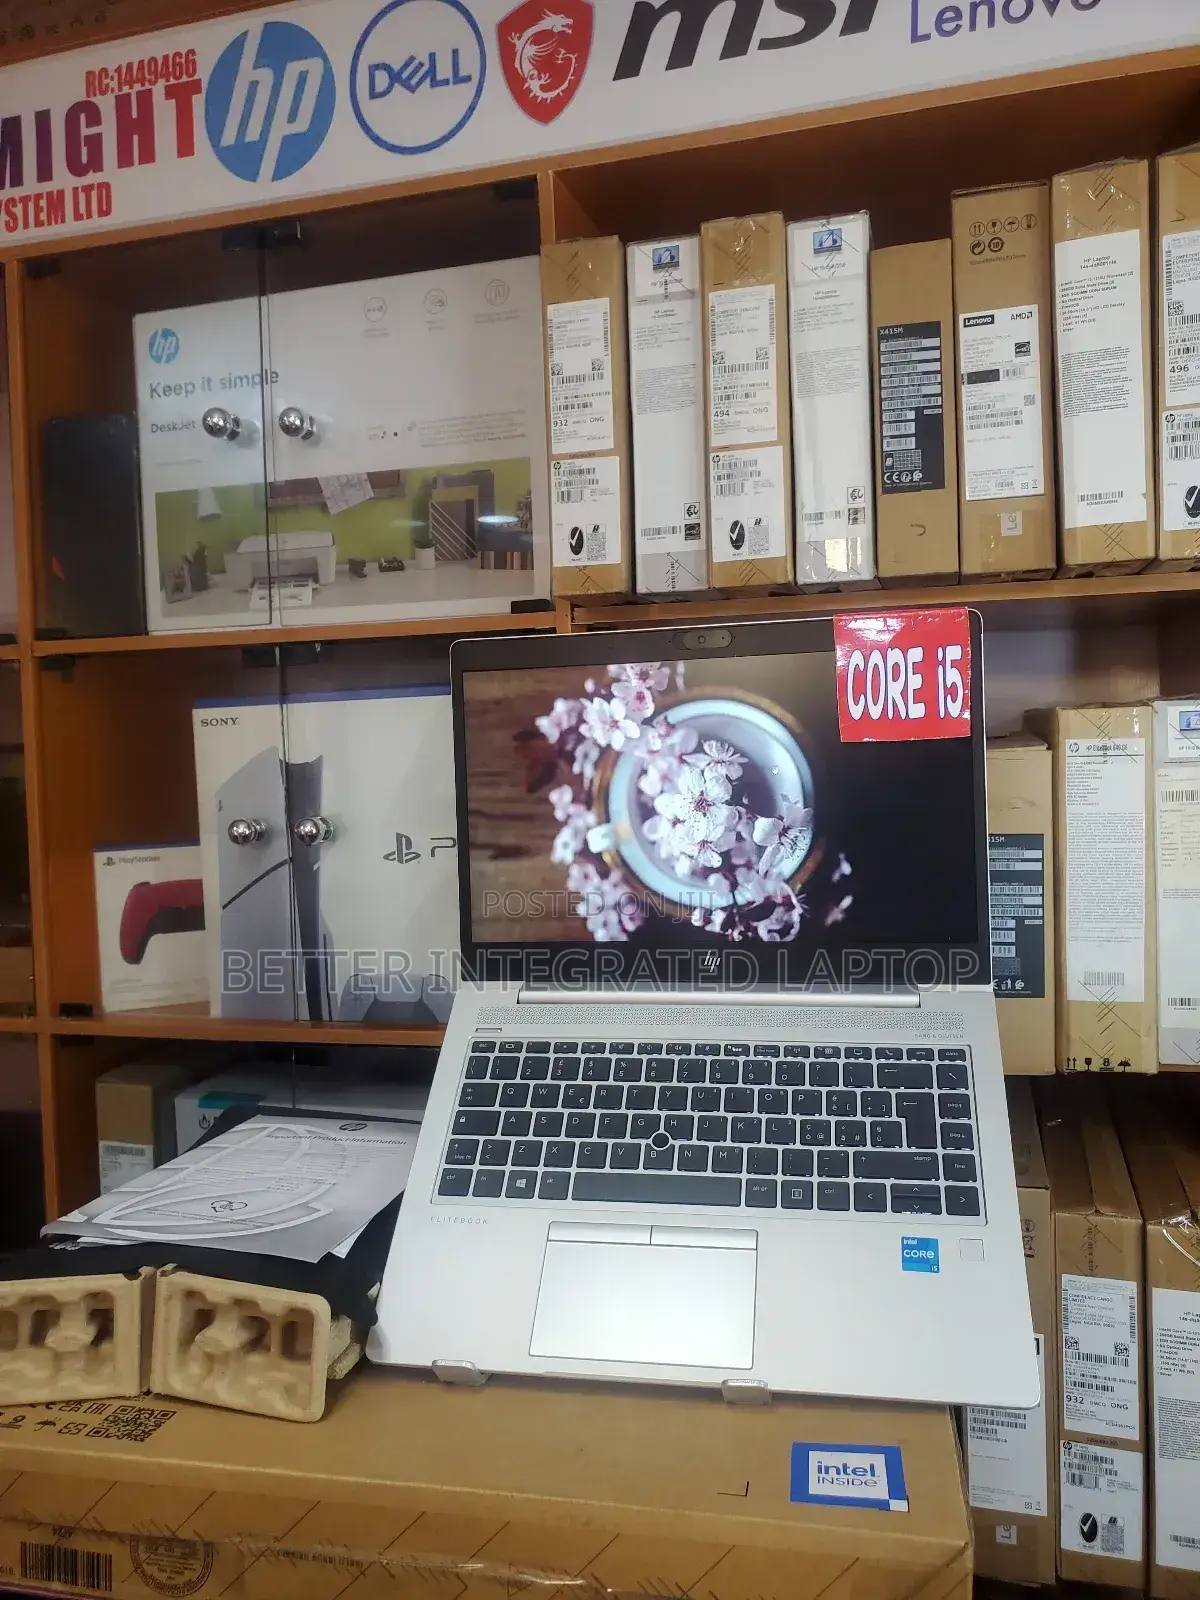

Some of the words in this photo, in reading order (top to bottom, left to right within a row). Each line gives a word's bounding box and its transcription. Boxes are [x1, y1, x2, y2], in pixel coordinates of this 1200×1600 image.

[85, 49, 197, 98] RC:1449466
[368, 48, 472, 101] DELL
[0, 188, 66, 233] STEM
[72, 181, 112, 222] LTD
[965, 316, 992, 326] Lenovo
[1010, 312, 1027, 321] AMD
[879, 327, 904, 336] X415M
[1170, 364, 1190, 374] 496
[149, 381, 196, 399] Keep
[202, 376, 212, 391] it
[219, 369, 280, 391] simple
[713, 410, 730, 418] 494
[752, 406, 768, 414] ONG
[151, 419, 196, 433] DeskJet
[553, 418, 568, 427] 932
[846, 645, 927, 721] CORE
[937, 644, 964, 719] i5
[200, 717, 239, 727] SONY
[350, 1137, 408, 1145] Information
[430, 1215, 489, 1225] ELITEBOOK
[902, 1238, 918, 1246] intel
[1066, 1394, 1084, 1405] 932
[1110, 1402, 1129, 1410] ONG
[817, 1460, 880, 1478] intel
